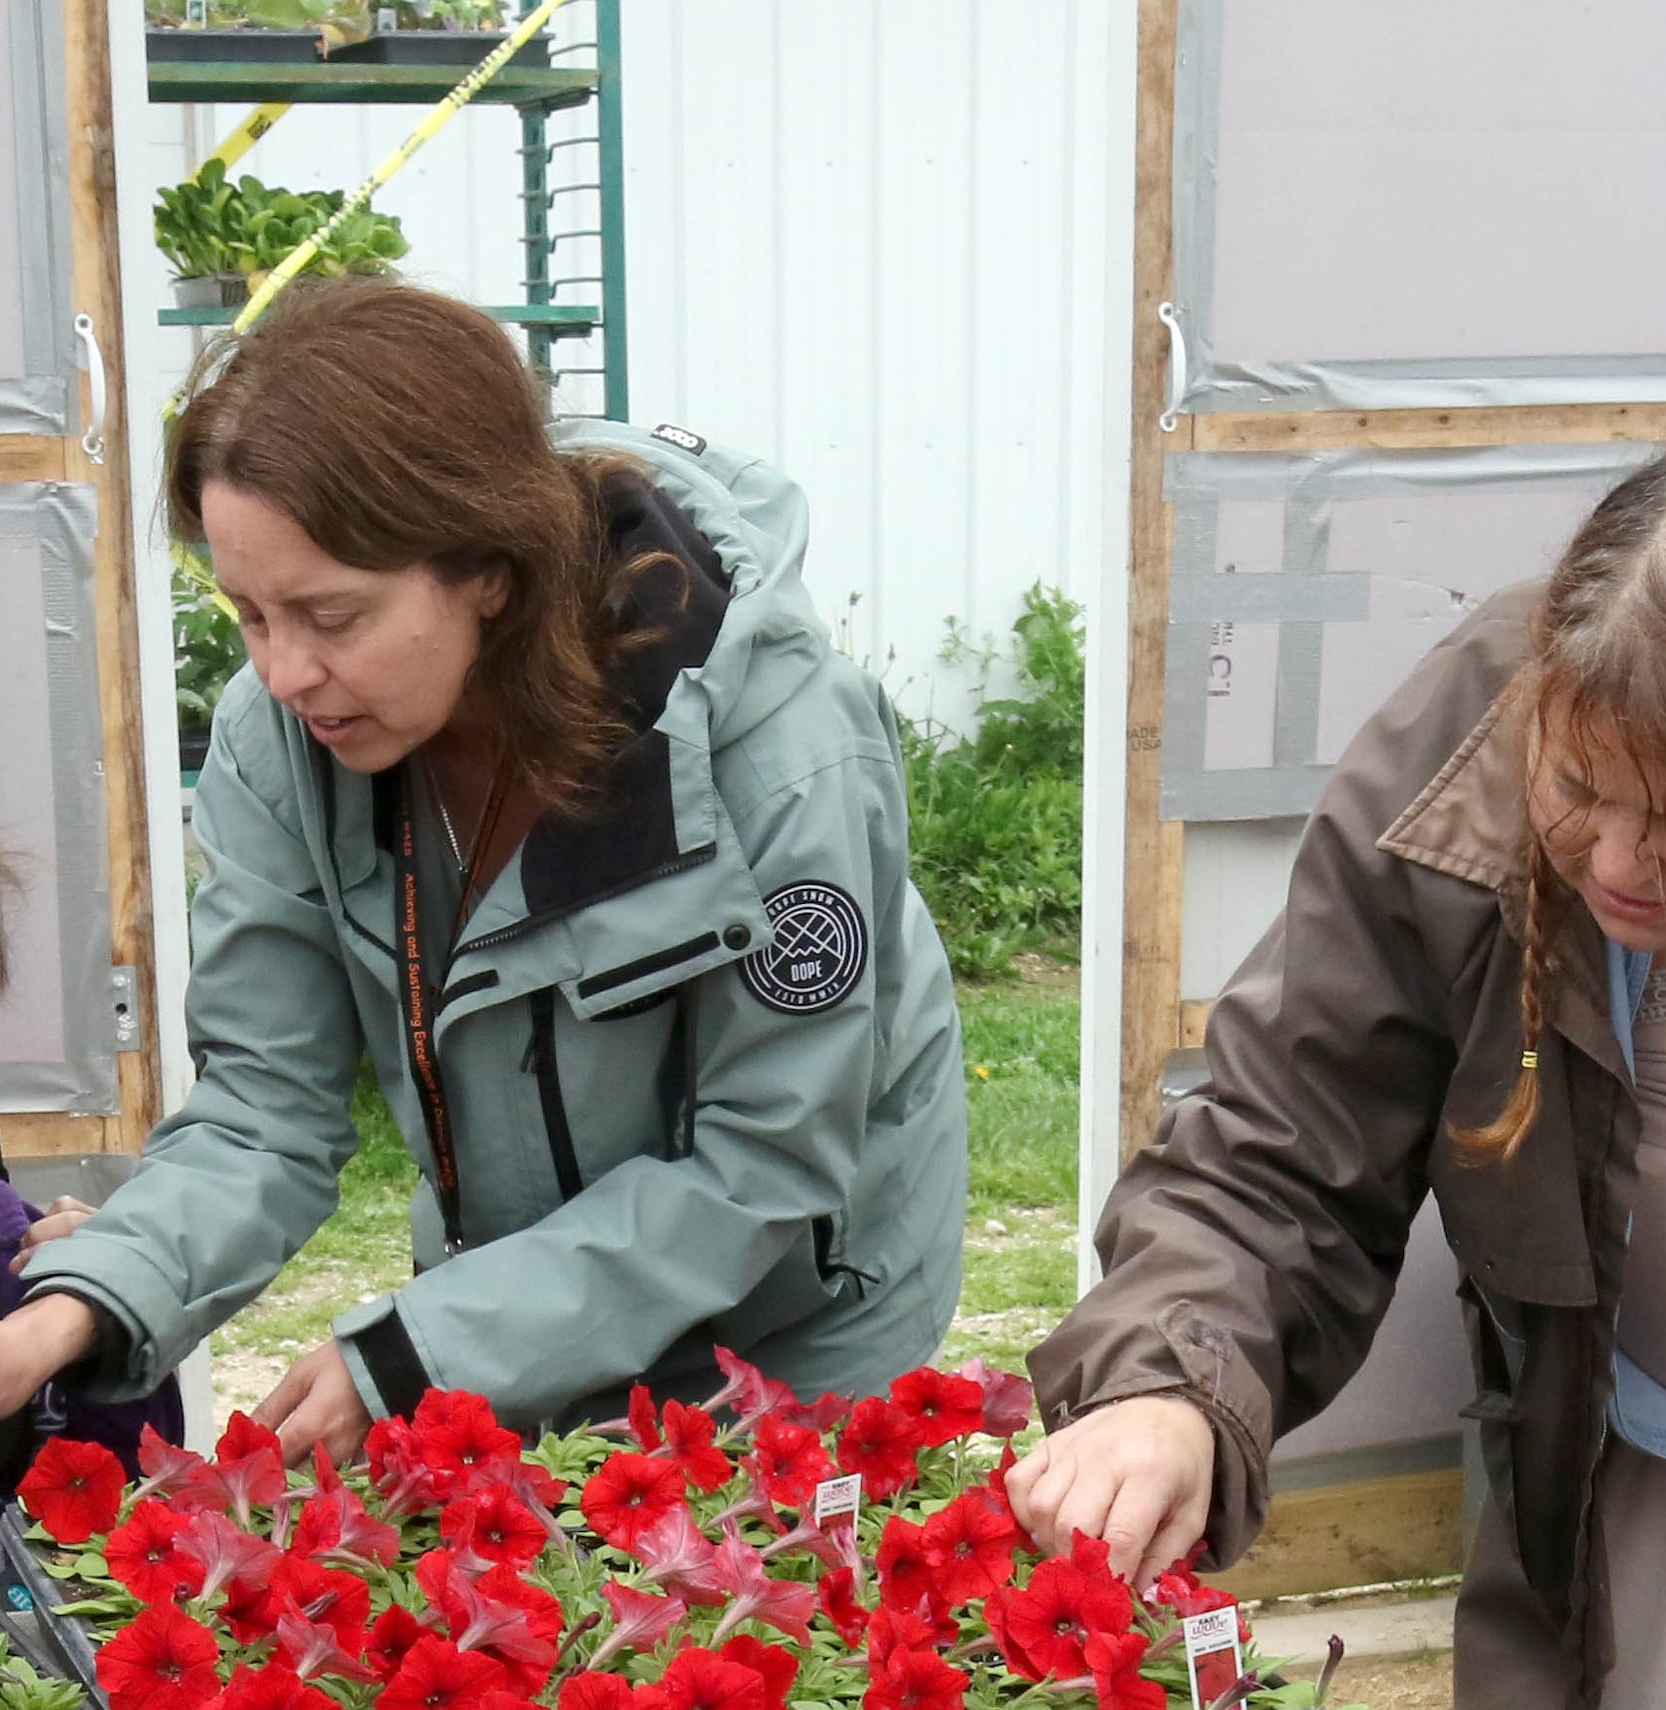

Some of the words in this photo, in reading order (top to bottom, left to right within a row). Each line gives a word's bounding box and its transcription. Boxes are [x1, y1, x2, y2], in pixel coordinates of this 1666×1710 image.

[1130, 727, 1158, 739] ADE
[403, 873, 417, 932] Achieving
[802, 891, 835, 906] SNOW
[407, 935, 420, 958] and
[791, 960, 823, 982] DOPE
[408, 963, 425, 1028] Sustaining
[412, 1030, 439, 1089] Excellence
[1192, 1619, 1228, 1635] wave
[1198, 1615, 1220, 1625] EASY
